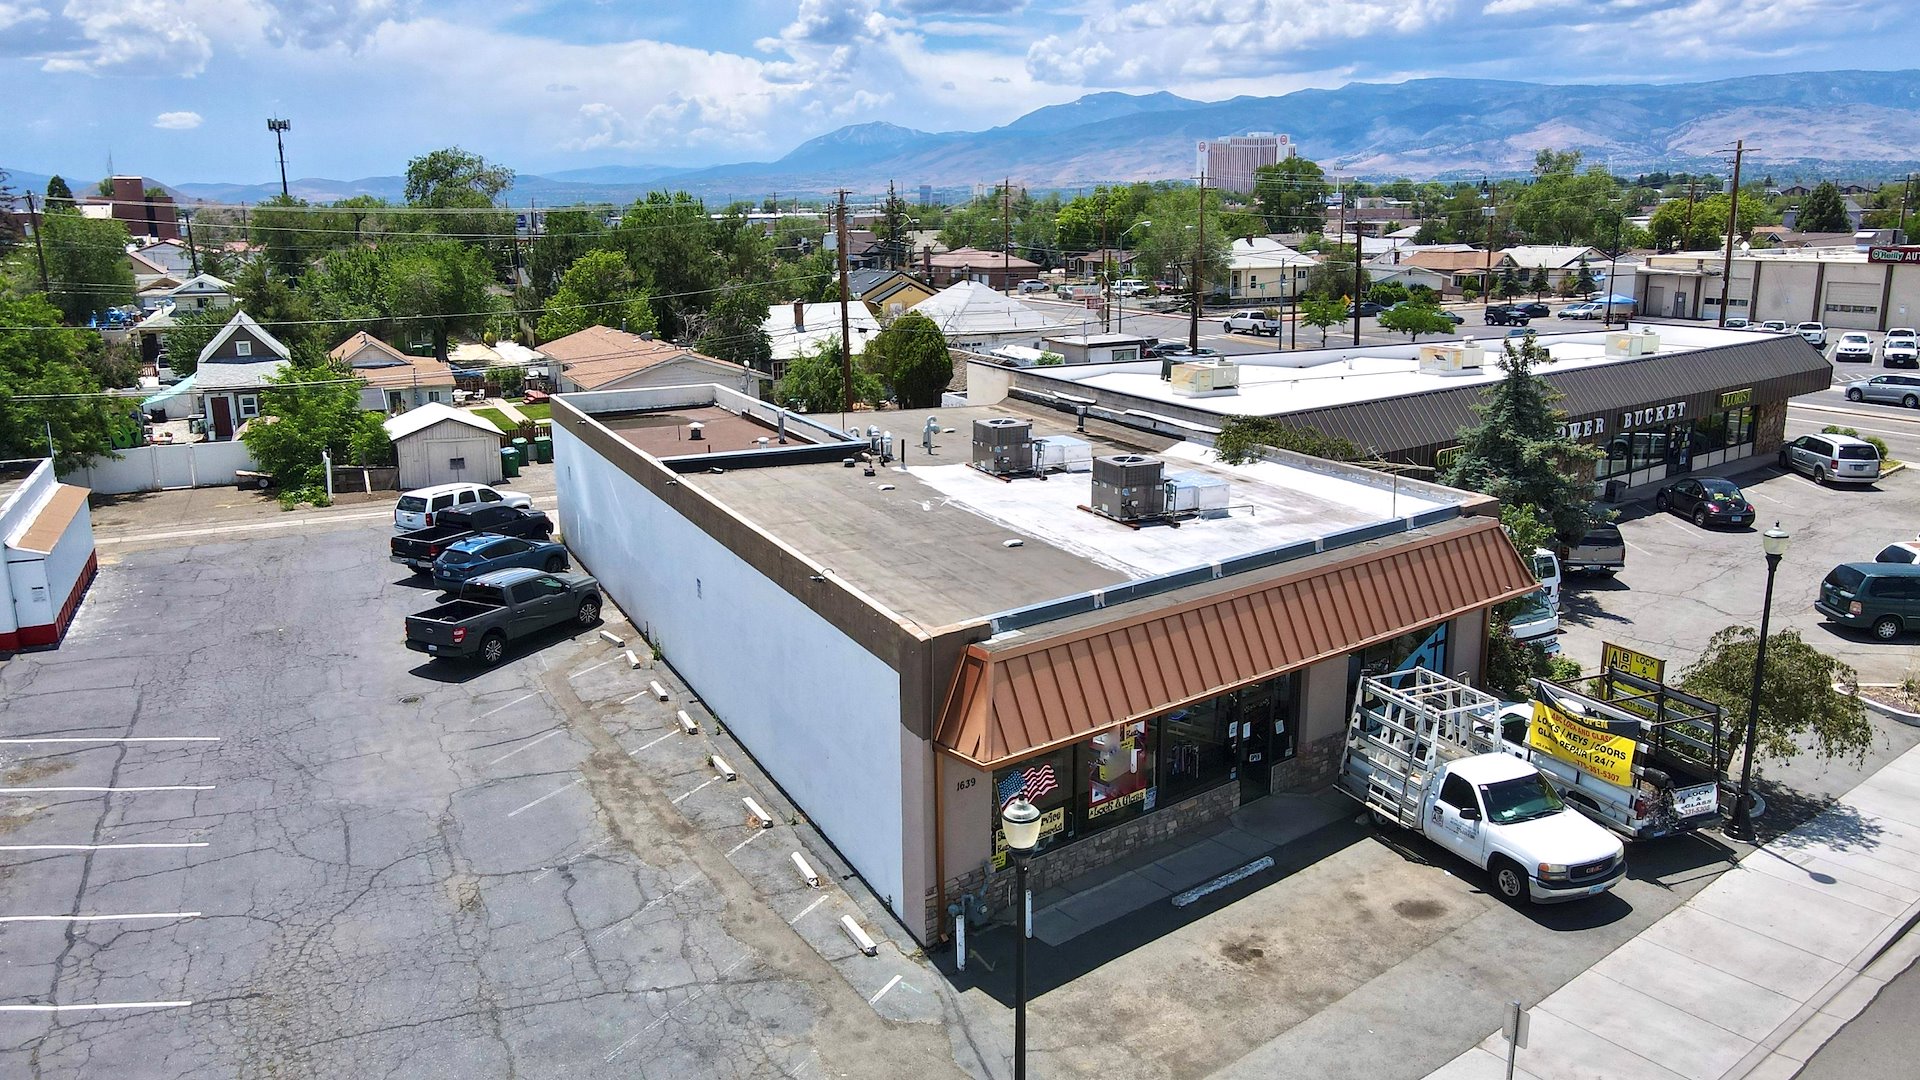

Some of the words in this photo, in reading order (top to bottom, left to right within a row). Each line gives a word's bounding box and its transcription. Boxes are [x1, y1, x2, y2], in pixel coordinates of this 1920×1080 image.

[1721, 389, 1752, 407] FLORIST
[1555, 417, 1605, 441] OWER
[1623, 401, 1687, 429] BUCKET
[1635, 655, 1656, 668] LOCK
[1566, 731, 1589, 746] KEYS
[1594, 755, 1616, 769] 24/7
[956, 777, 976, 791] 1639
[1688, 789, 1711, 797] LOCK
